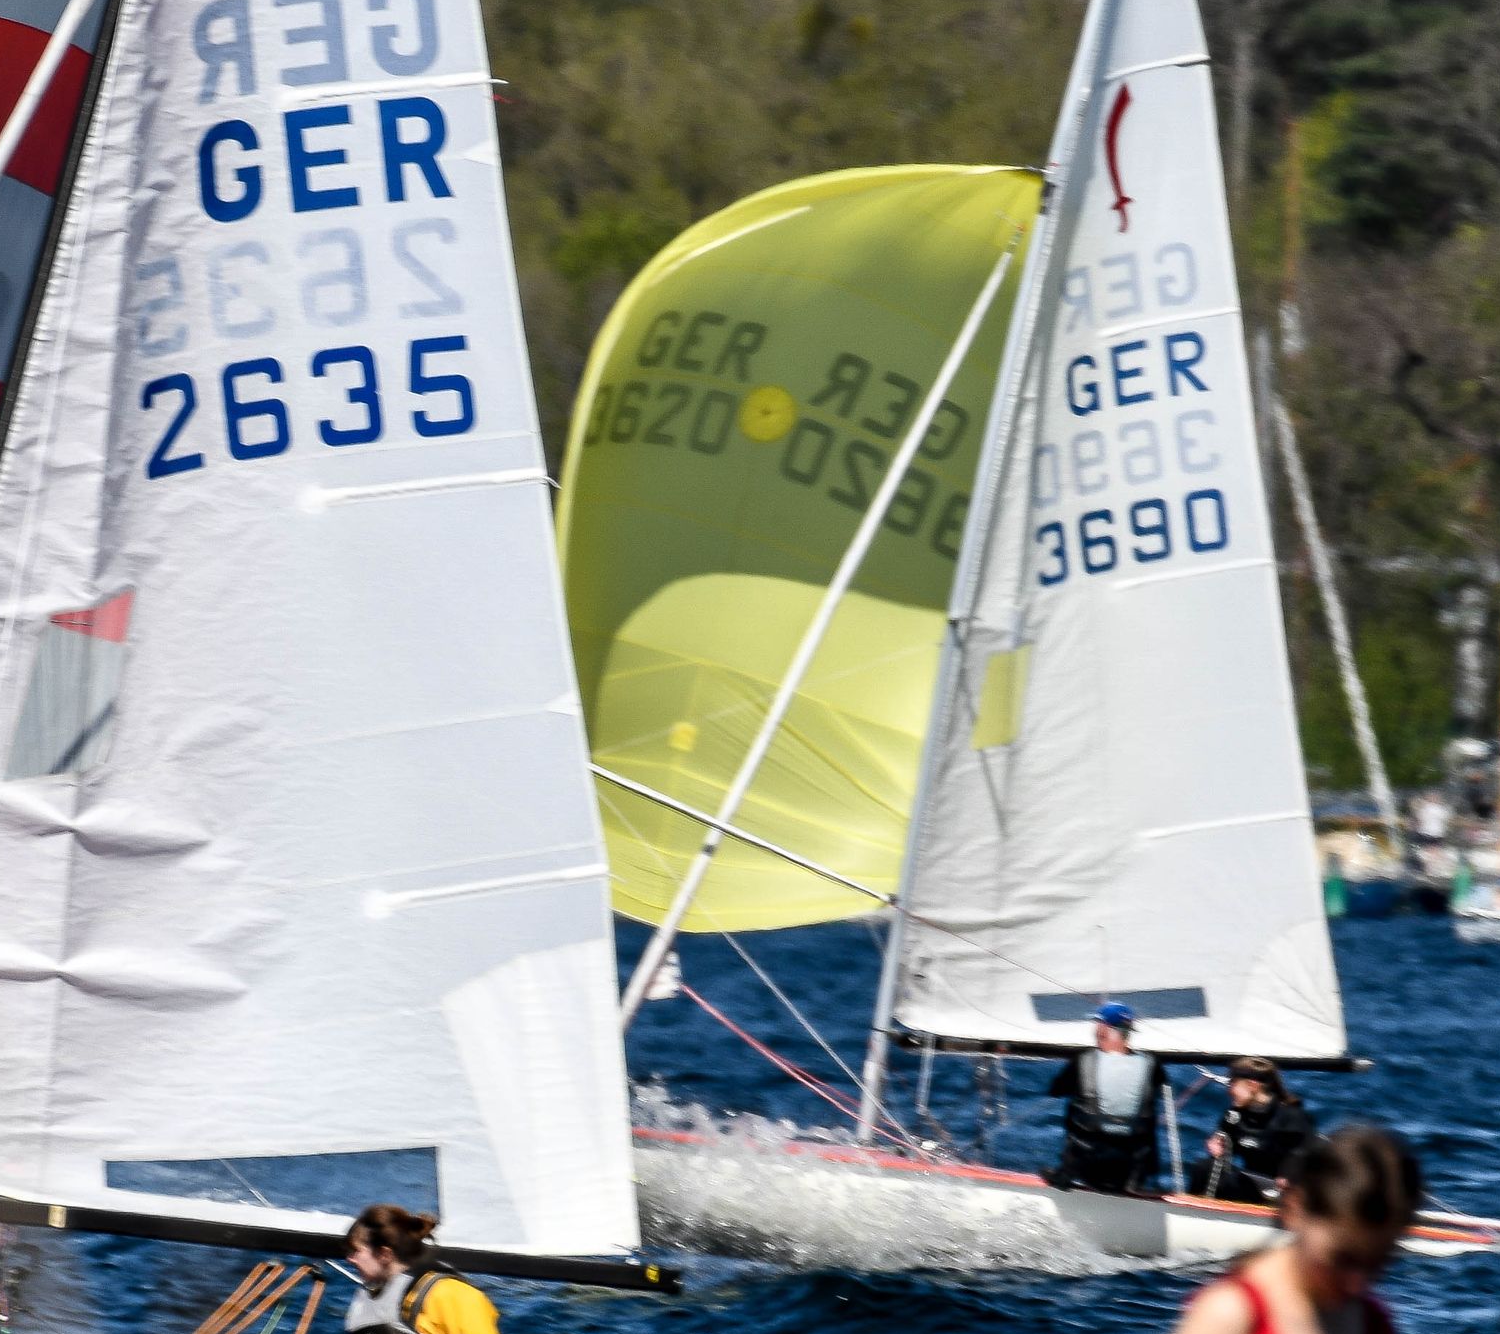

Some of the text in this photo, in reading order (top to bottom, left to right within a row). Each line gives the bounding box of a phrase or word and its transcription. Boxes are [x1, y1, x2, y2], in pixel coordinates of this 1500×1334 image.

[200, 96, 456, 222] GER
[637, 310, 767, 383] GER
[1066, 331, 1211, 417] GER
[142, 335, 477, 479] 2635
[1036, 488, 1230, 587] 3690
